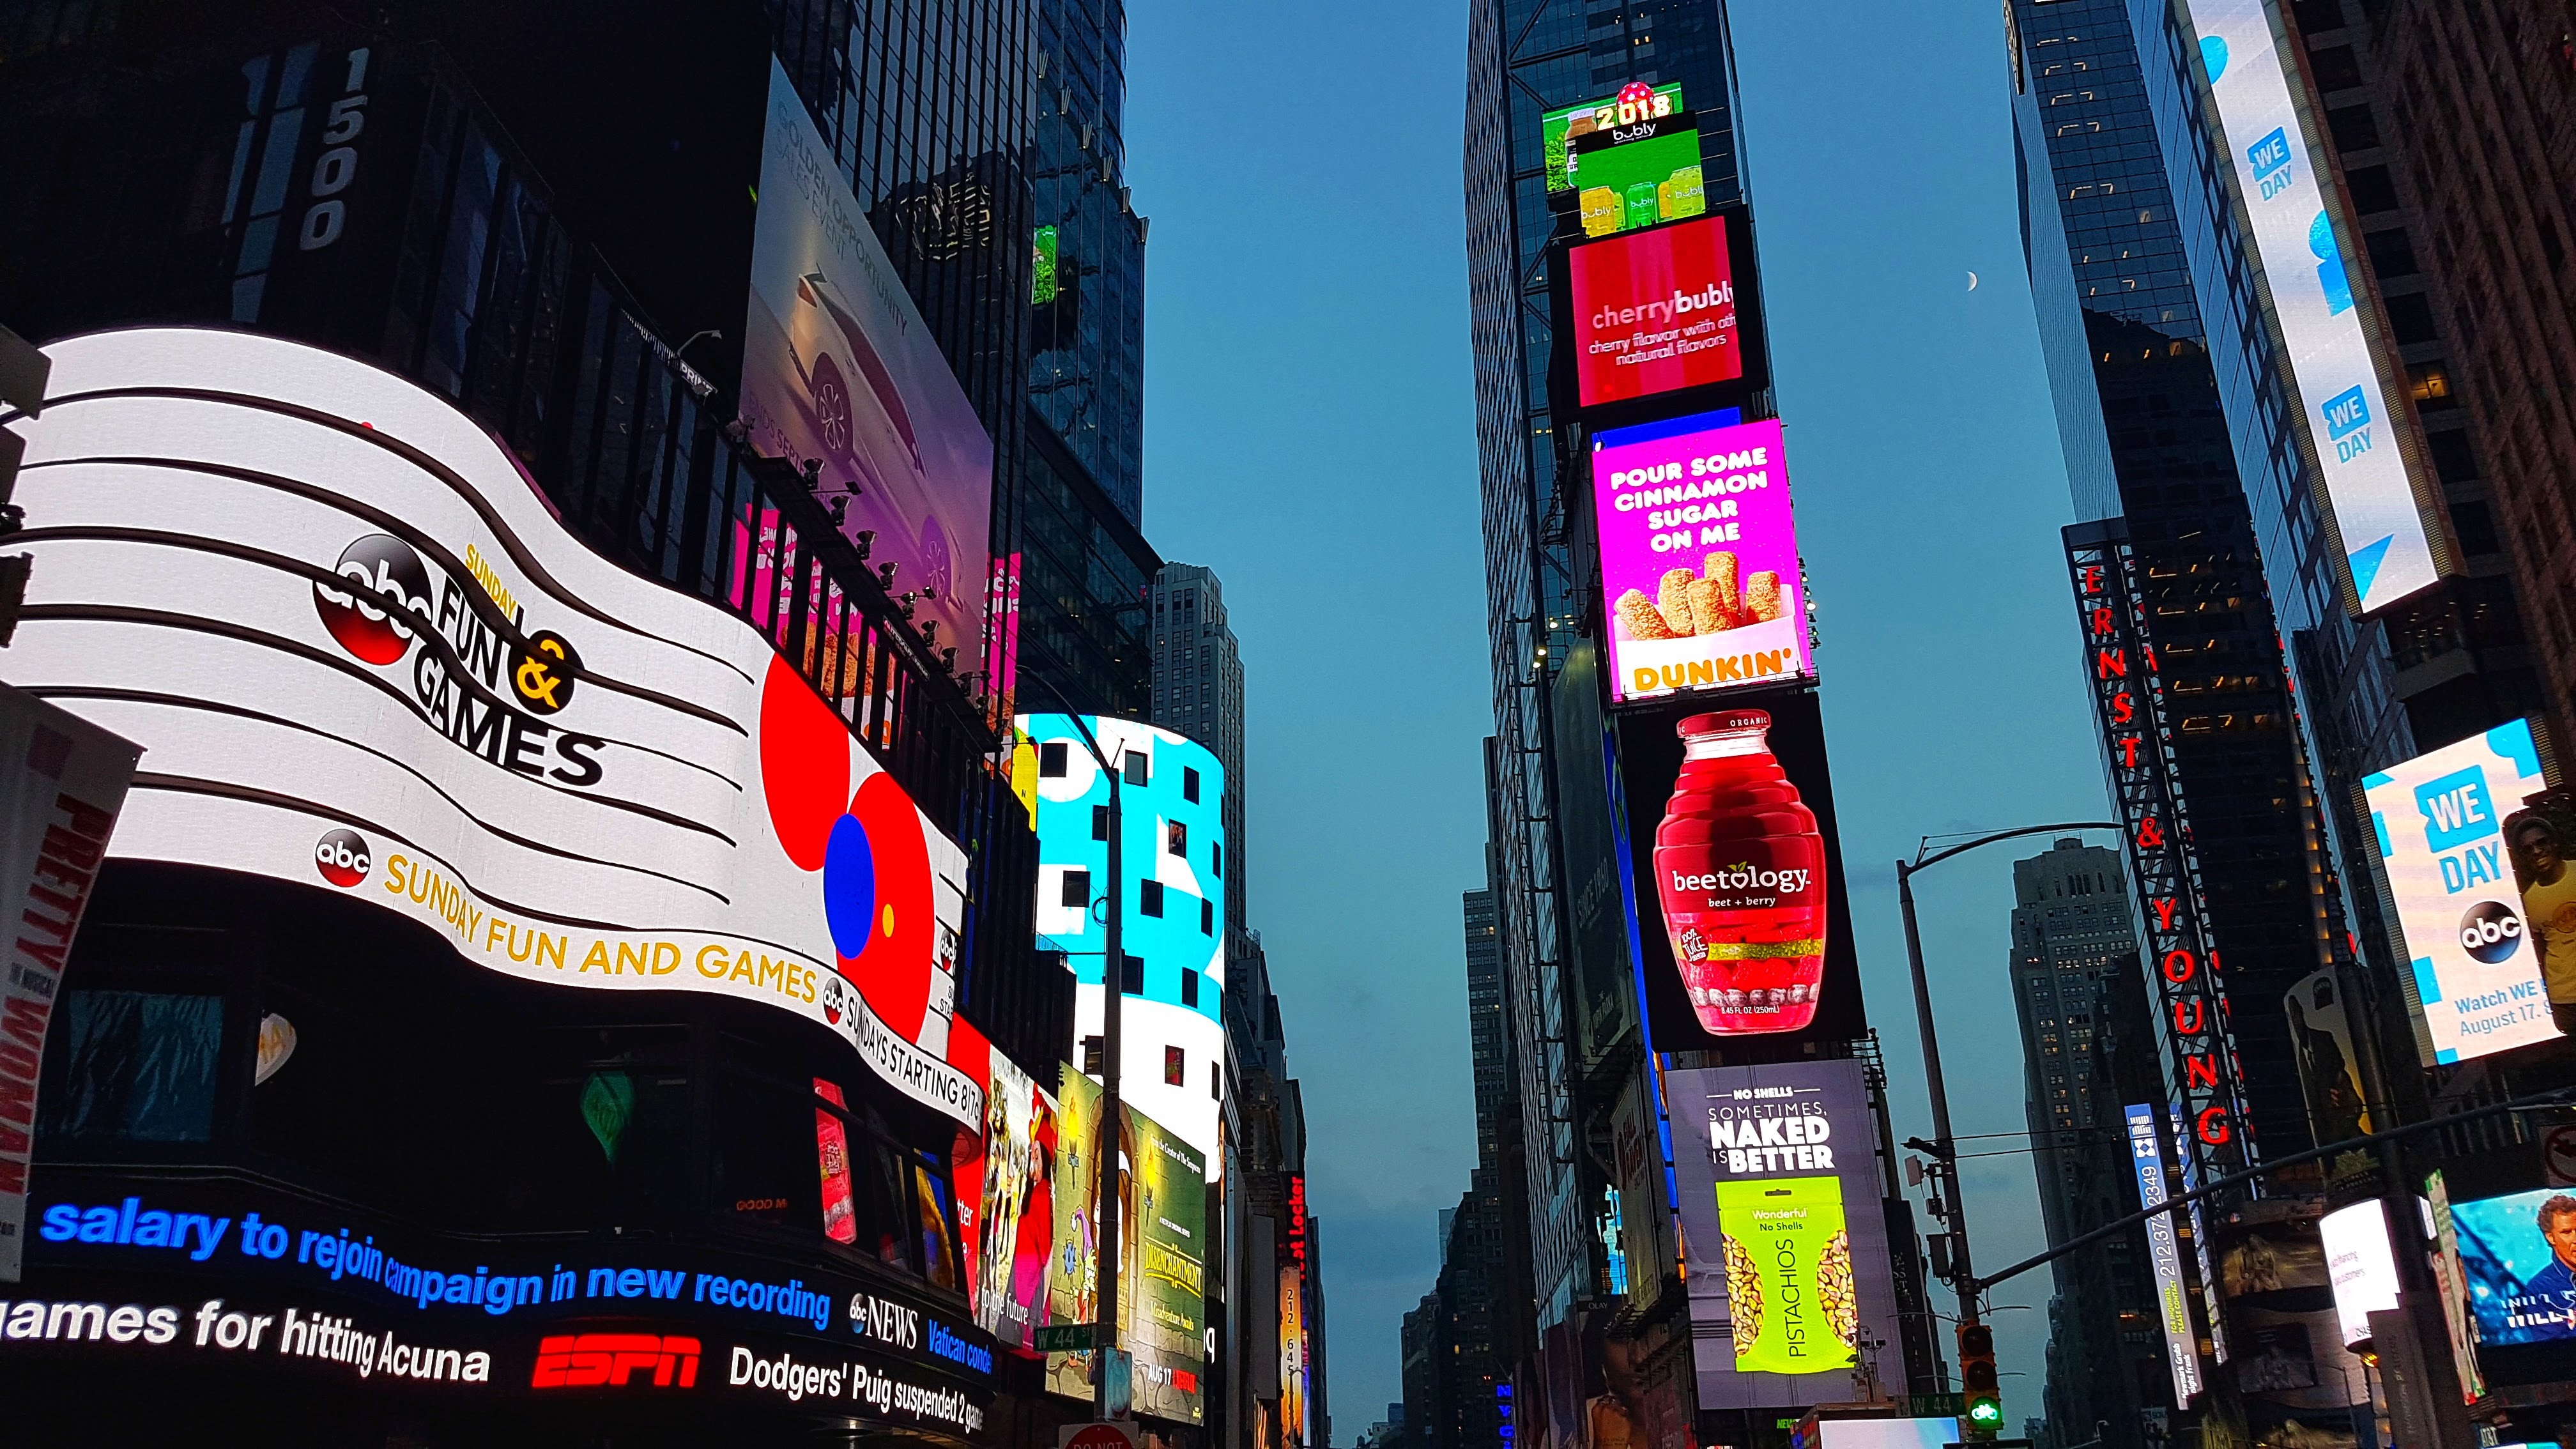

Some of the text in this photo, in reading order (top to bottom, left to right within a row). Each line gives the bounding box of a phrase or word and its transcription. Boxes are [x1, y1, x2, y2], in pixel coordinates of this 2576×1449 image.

[1596, 95, 1672, 130] 2018
[300, 47, 370, 250] 1500
[1613, 123, 1657, 141] bubly
[2253, 136, 2286, 172] WE
[775, 127, 847, 260] SALES EVENT
[2260, 164, 2292, 202] DAY
[778, 102, 907, 335] GOLDEN OPPORTUNITY
[1581, 205, 1611, 219] bubly
[1630, 197, 1654, 208] bubly
[1589, 338, 1631, 354] cherry
[1632, 329, 1681, 347] flavor
[1682, 318, 1716, 337] with
[1616, 334, 1727, 365] natural flavors
[2328, 395, 2363, 430] WE
[2335, 426, 2373, 464] DAY
[1610, 447, 1768, 491] POUR SOME
[1614, 470, 1768, 512] CINNAMON
[1648, 499, 1738, 530] SUGAR
[1650, 522, 1741, 553] ON ME
[316, 558, 433, 640] abc
[465, 543, 517, 620] SUNDAY
[438, 574, 504, 692] FUN
[1634, 647, 1792, 691] DUNKIN'
[2086, 565, 2140, 769] ERNST
[414, 643, 606, 786] GAMES
[1729, 717, 1768, 727] ORGANIC
[2427, 783, 2487, 834] WE
[2137, 817, 2165, 849] &
[316, 839, 370, 874] abc
[2439, 840, 2503, 895] DAY
[15, 791, 115, 974] PRETTY
[1708, 898, 1731, 908] beet
[1745, 896, 1776, 908] berry
[384, 854, 816, 1004] SUNDAY FUN AND GAMES
[2461, 914, 2522, 949] abc
[1682, 936, 1708, 962] JUICE
[2455, 988, 2509, 1014] Watch
[2509, 979, 2539, 999] WE
[2152, 897, 2230, 1146] YOUNG
[2460, 1009, 2517, 1036] August
[823, 986, 843, 1011] abc
[847, 996, 888, 1066] SUNDAYS
[889, 1043, 958, 1105] STARTING
[1733, 1087, 1793, 1100] NO SHELLS
[1708, 1116, 1830, 1150] NAKED
[1712, 1144, 1836, 1174] IS BETTER
[1288, 1176, 1305, 1236] Locker
[1751, 1207, 1808, 1220] Wonderful
[2141, 1165, 2176, 1277] 212.3722349
[1759, 1221, 1804, 1232] No Shells
[1144, 1241, 1202, 1292] DISENCHANTMENT
[40, 1196, 993, 1376] salary to rejoin campaign in new recording abc NEWS Vatican conde
[1775, 1238, 1807, 1358] PISTACHIOS
[981, 1287, 1029, 1326] to the future
[1588, 1301, 1608, 1310] OLAY
[194, 1298, 273, 1351] for
[281, 1307, 377, 1378] hitting
[376, 1330, 491, 1382] Acuna
[1037, 1329, 1050, 1349] W
[1054, 1328, 1075, 1348] 44
[530, 1334, 702, 1389] ESPN
[730, 1345, 849, 1402] Dodgers'
[852, 1365, 892, 1414] Puig
[894, 1378, 958, 1423] suspended
[958, 1393, 965, 1425] 2
[1147, 1363, 1163, 1384] AUG
[1163, 1367, 1172, 1386] 17
[2186, 1374, 2197, 1394] night
[1912, 1397, 1925, 1414] W
[1933, 1396, 1951, 1413] 44
